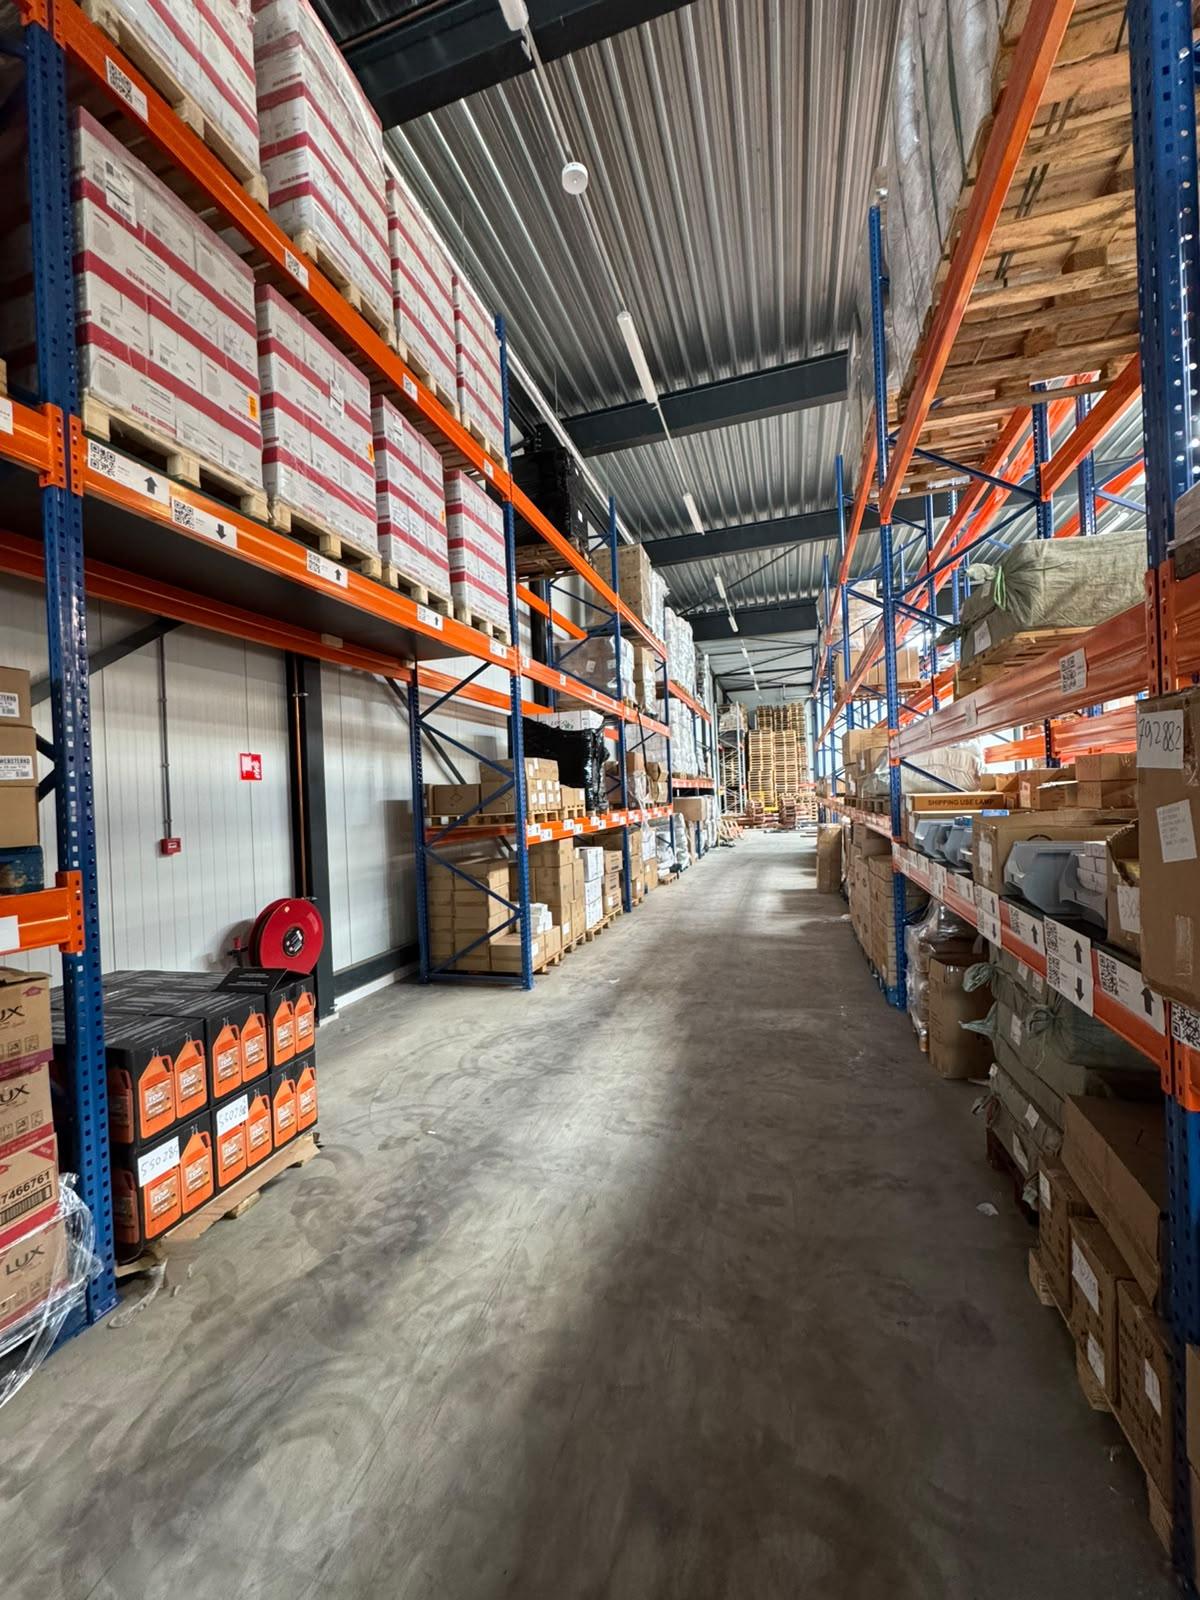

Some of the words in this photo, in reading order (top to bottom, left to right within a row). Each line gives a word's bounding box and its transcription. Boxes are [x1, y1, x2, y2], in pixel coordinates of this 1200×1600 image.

[1138, 717, 1182, 752] 792882
[0, 1083, 29, 1106] UX
[1, 1171, 51, 1204] 7466761
[6, 1244, 45, 1276] LUX
